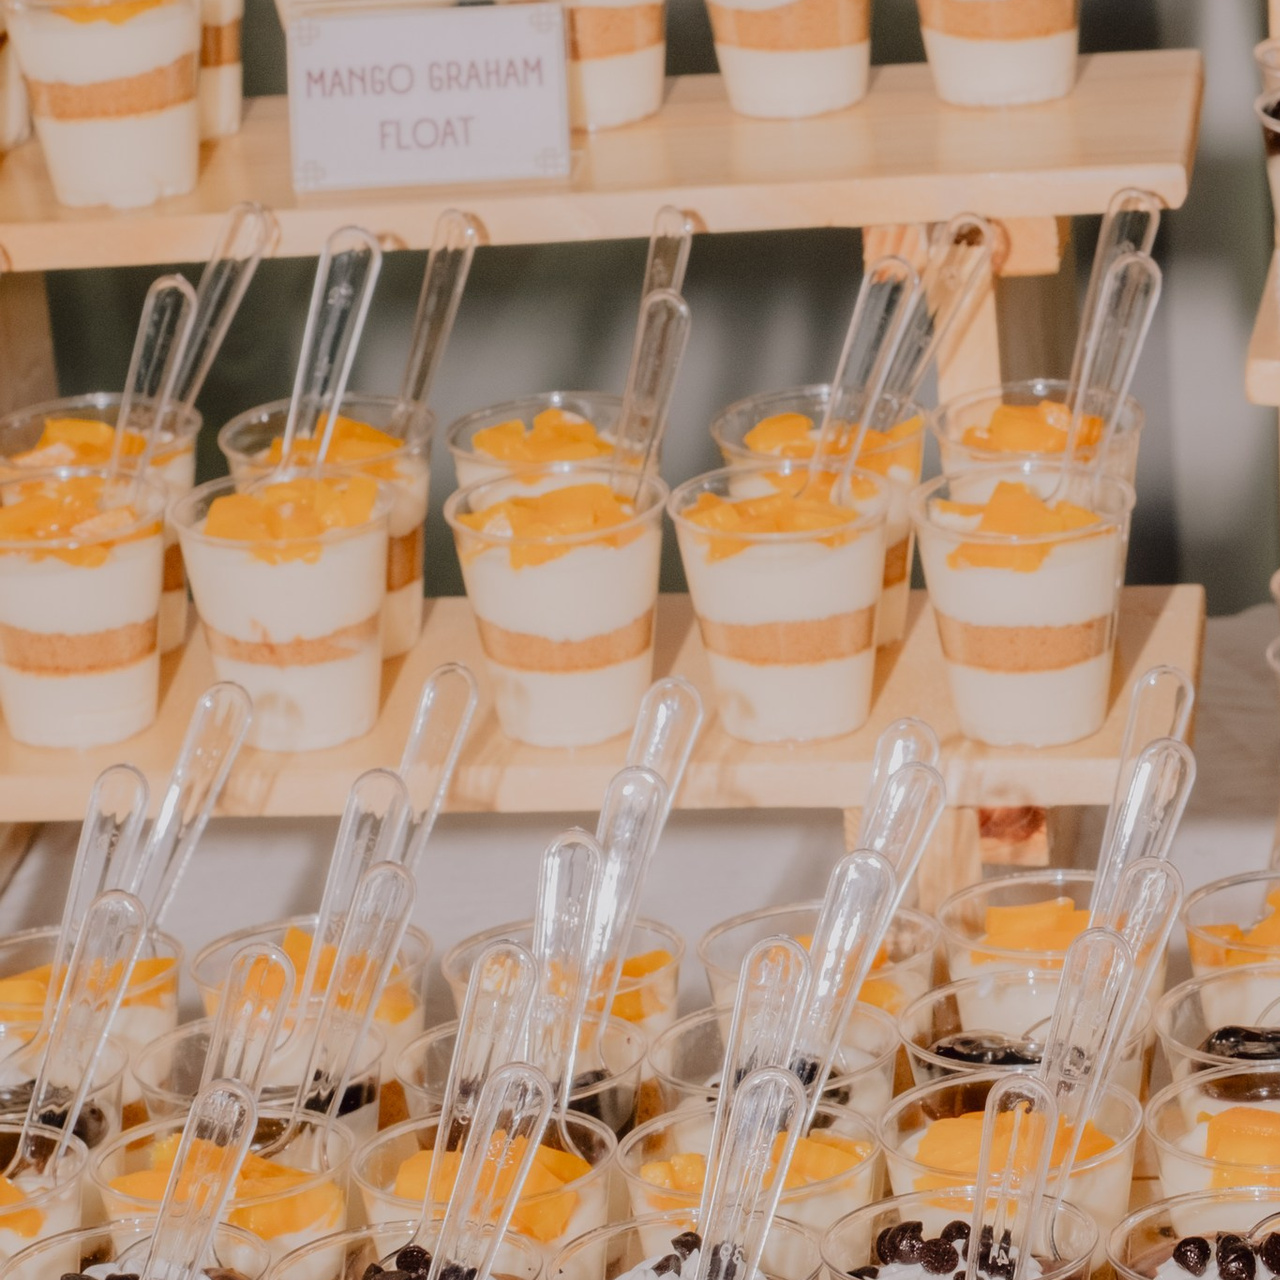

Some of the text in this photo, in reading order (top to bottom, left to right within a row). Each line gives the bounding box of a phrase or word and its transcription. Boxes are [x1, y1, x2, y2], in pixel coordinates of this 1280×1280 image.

[305, 57, 544, 98] MANGO GRAHAM
[379, 116, 474, 151] FLOAT
